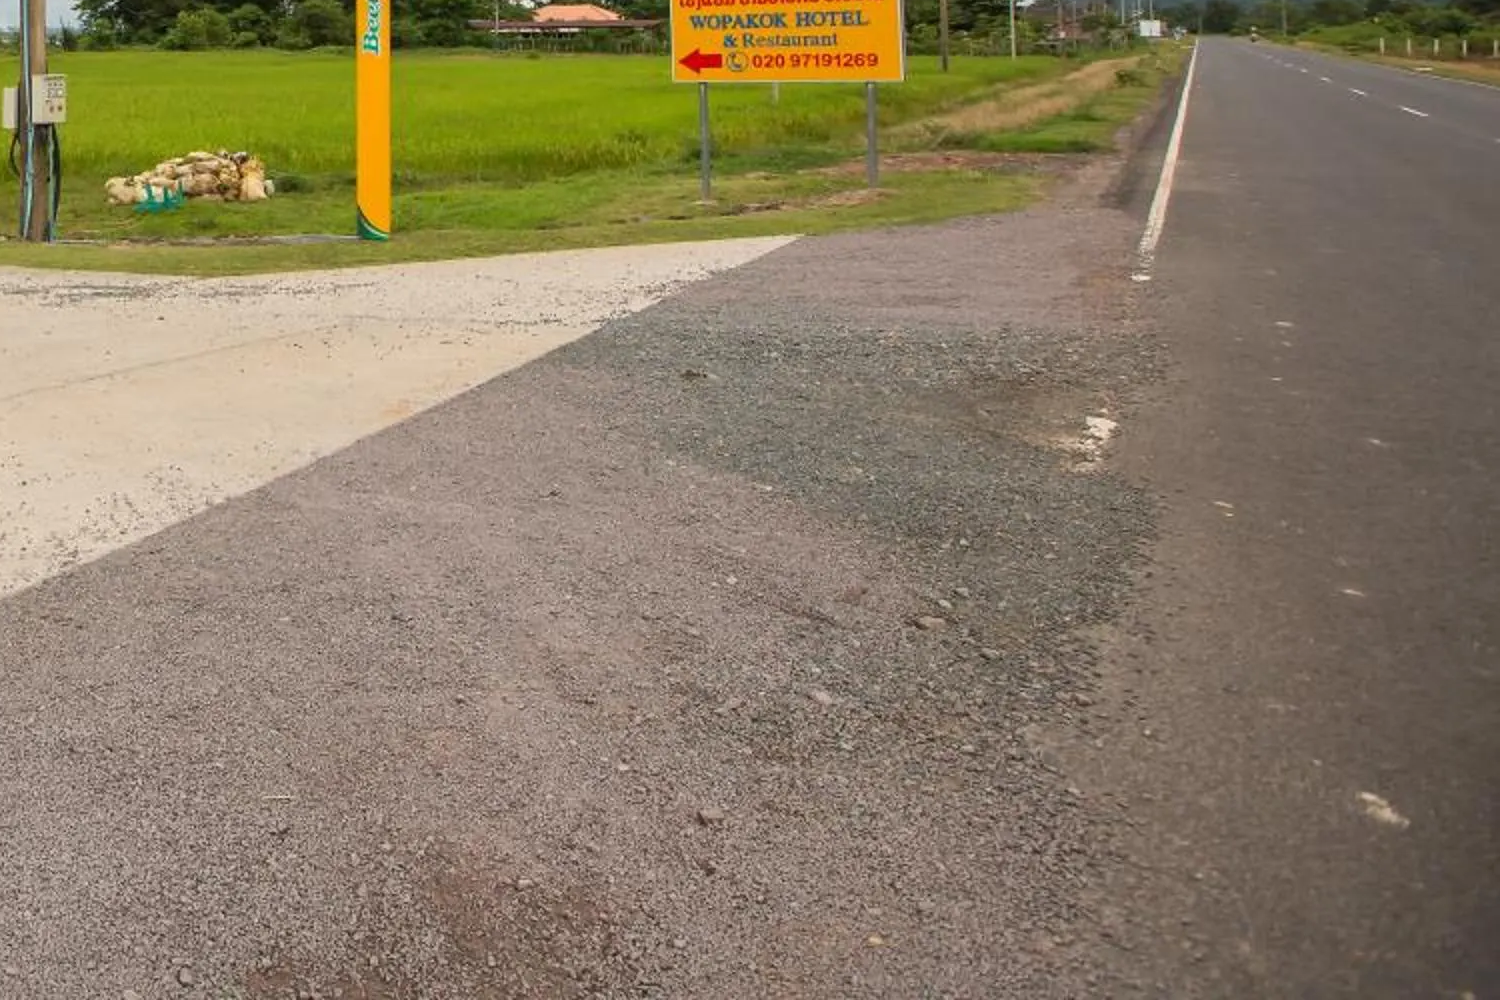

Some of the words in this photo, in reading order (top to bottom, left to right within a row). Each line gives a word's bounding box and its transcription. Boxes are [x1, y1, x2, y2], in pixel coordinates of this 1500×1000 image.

[690, 14, 788, 29] WOPAKOK
[796, 10, 868, 27] HOTEL
[723, 36, 737, 48] &
[743, 33, 838, 48] Restaurant
[752, 55, 785, 68] 020
[790, 54, 878, 67] 97191269
